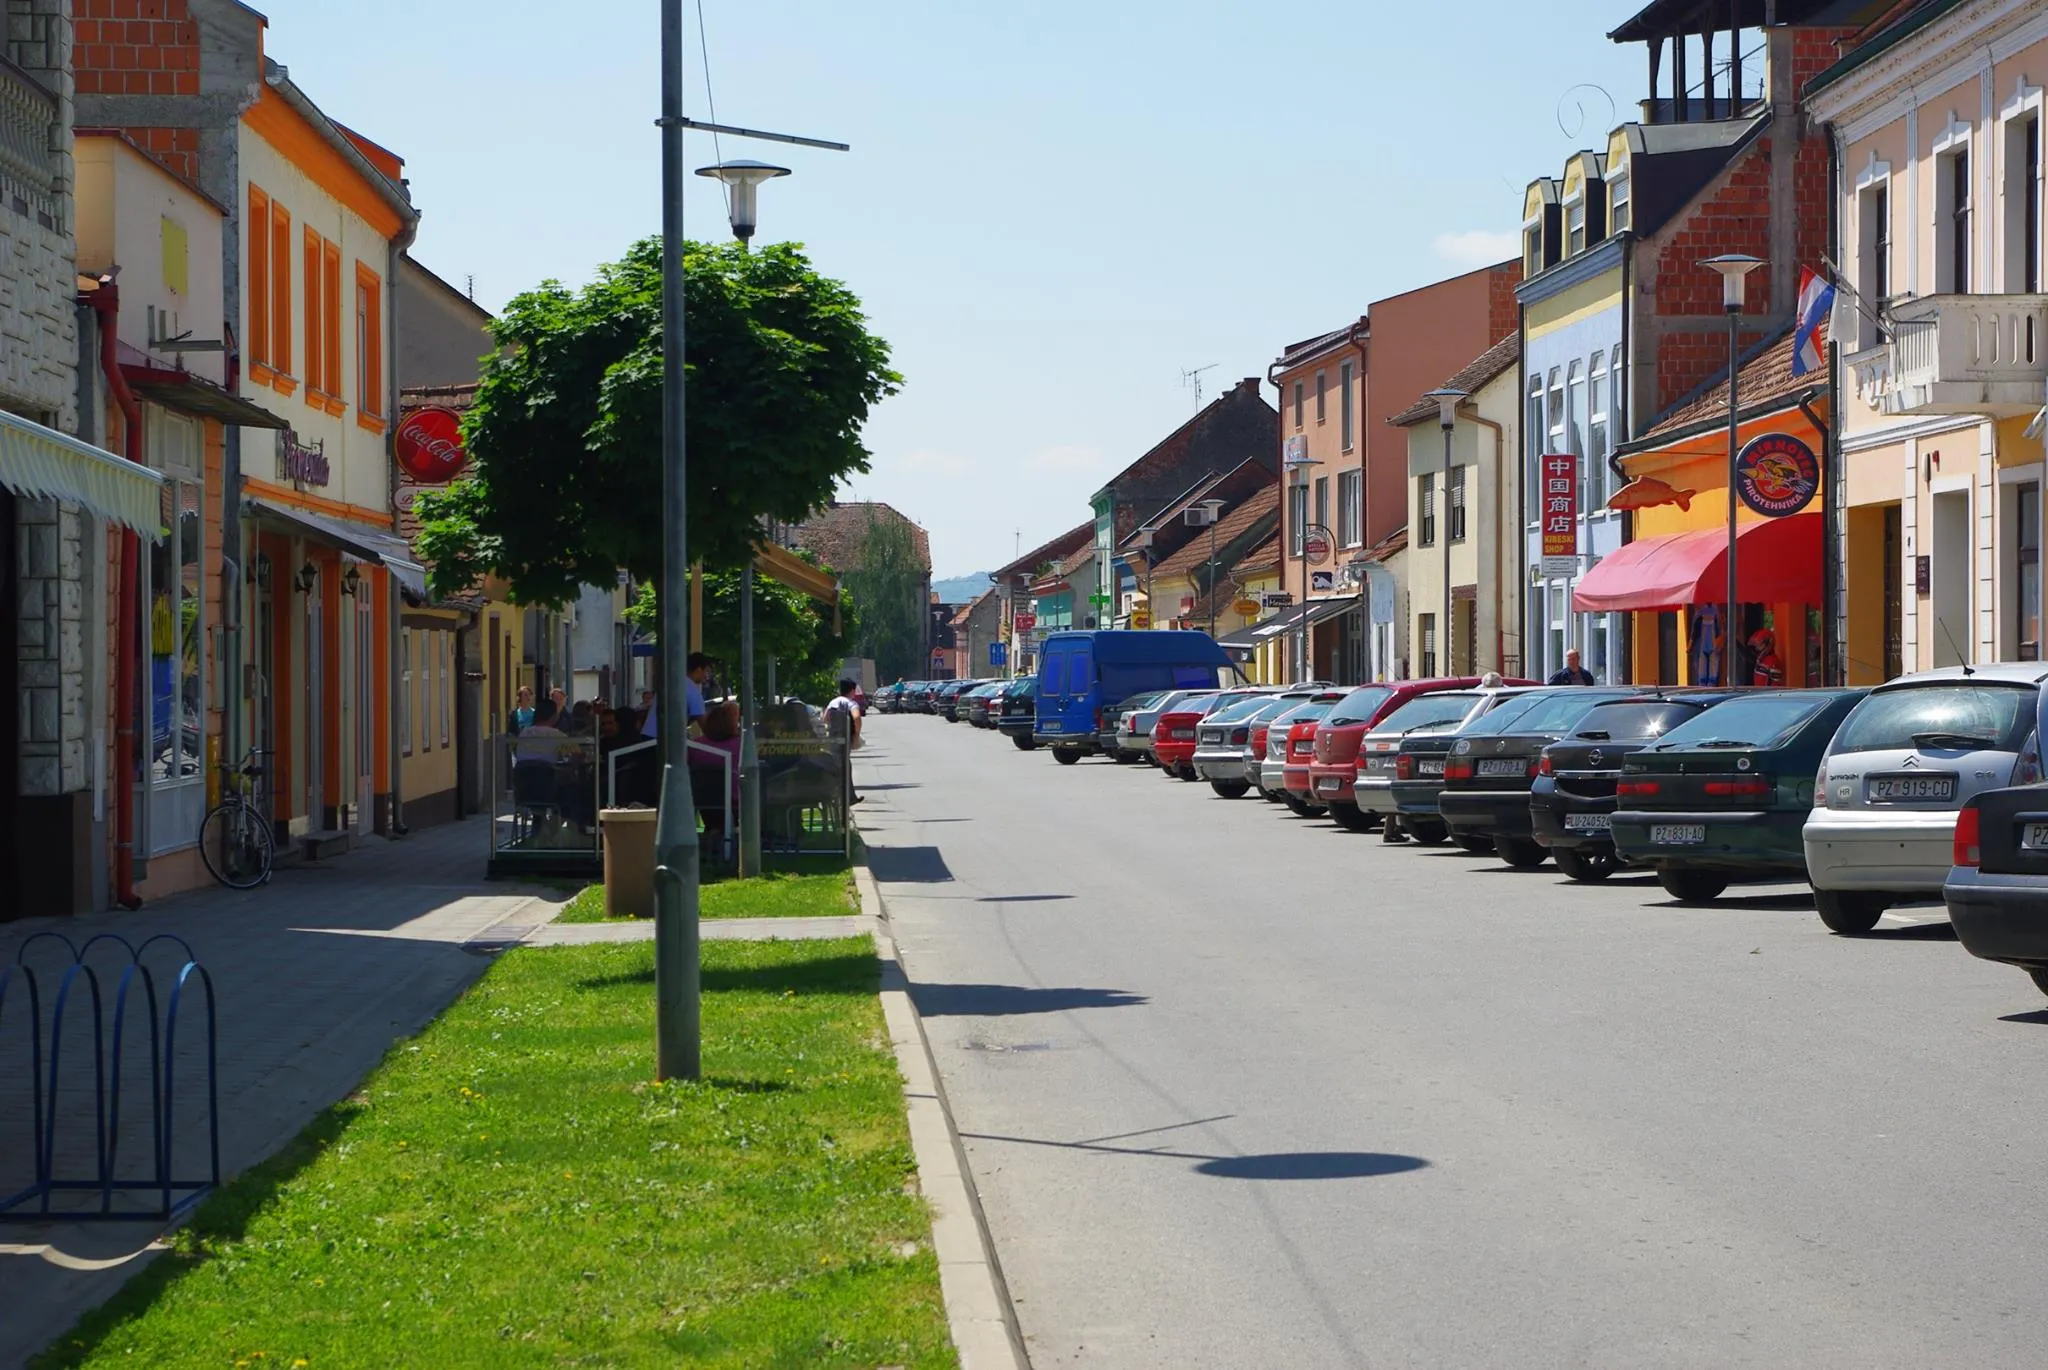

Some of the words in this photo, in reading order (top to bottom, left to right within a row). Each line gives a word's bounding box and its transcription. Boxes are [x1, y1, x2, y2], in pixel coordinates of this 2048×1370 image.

[1745, 439, 1815, 478] MIRNOVEC
[1547, 458, 1572, 532] 中国商店
[1743, 479, 1804, 510] PIROTEHNIKA
[1544, 545, 1565, 553] SHOP
[1877, 781, 1892, 796] PZ
[1902, 781, 1949, 796] 919-CD
[1656, 828, 1666, 839] PZ
